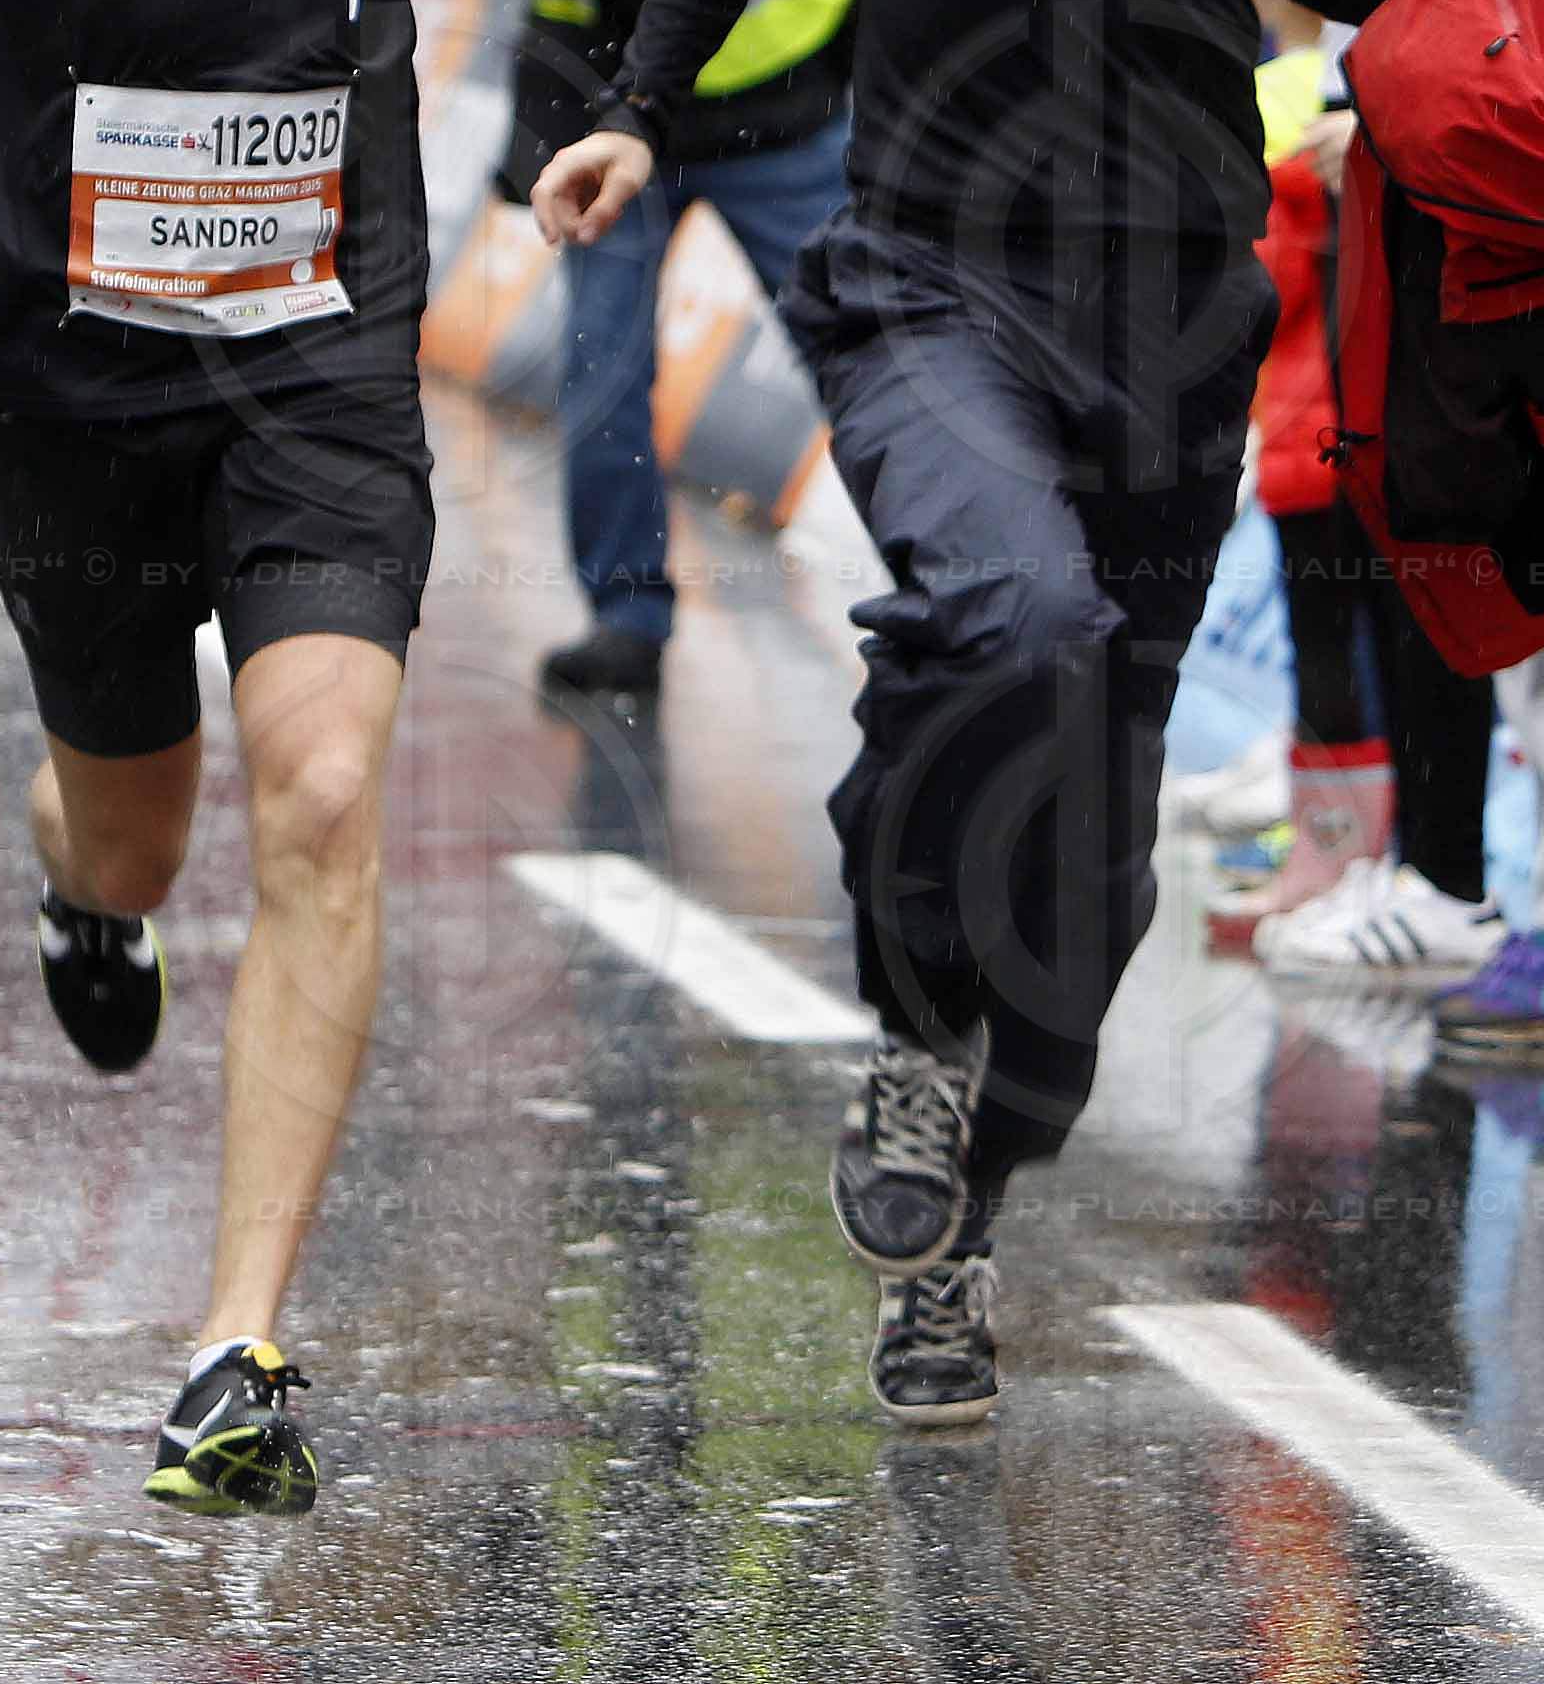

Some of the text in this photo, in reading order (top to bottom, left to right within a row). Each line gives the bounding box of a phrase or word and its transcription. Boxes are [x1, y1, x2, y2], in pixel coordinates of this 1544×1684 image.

[95, 131, 179, 149] SPARKASSE
[95, 178, 138, 195] KLEINE
[142, 181, 195, 199] ZEITUNG
[199, 183, 232, 200] GRAZ
[235, 181, 298, 200] MARATHON
[151, 215, 278, 249] SANDRO
[90, 269, 206, 293] Staffelmarathon
